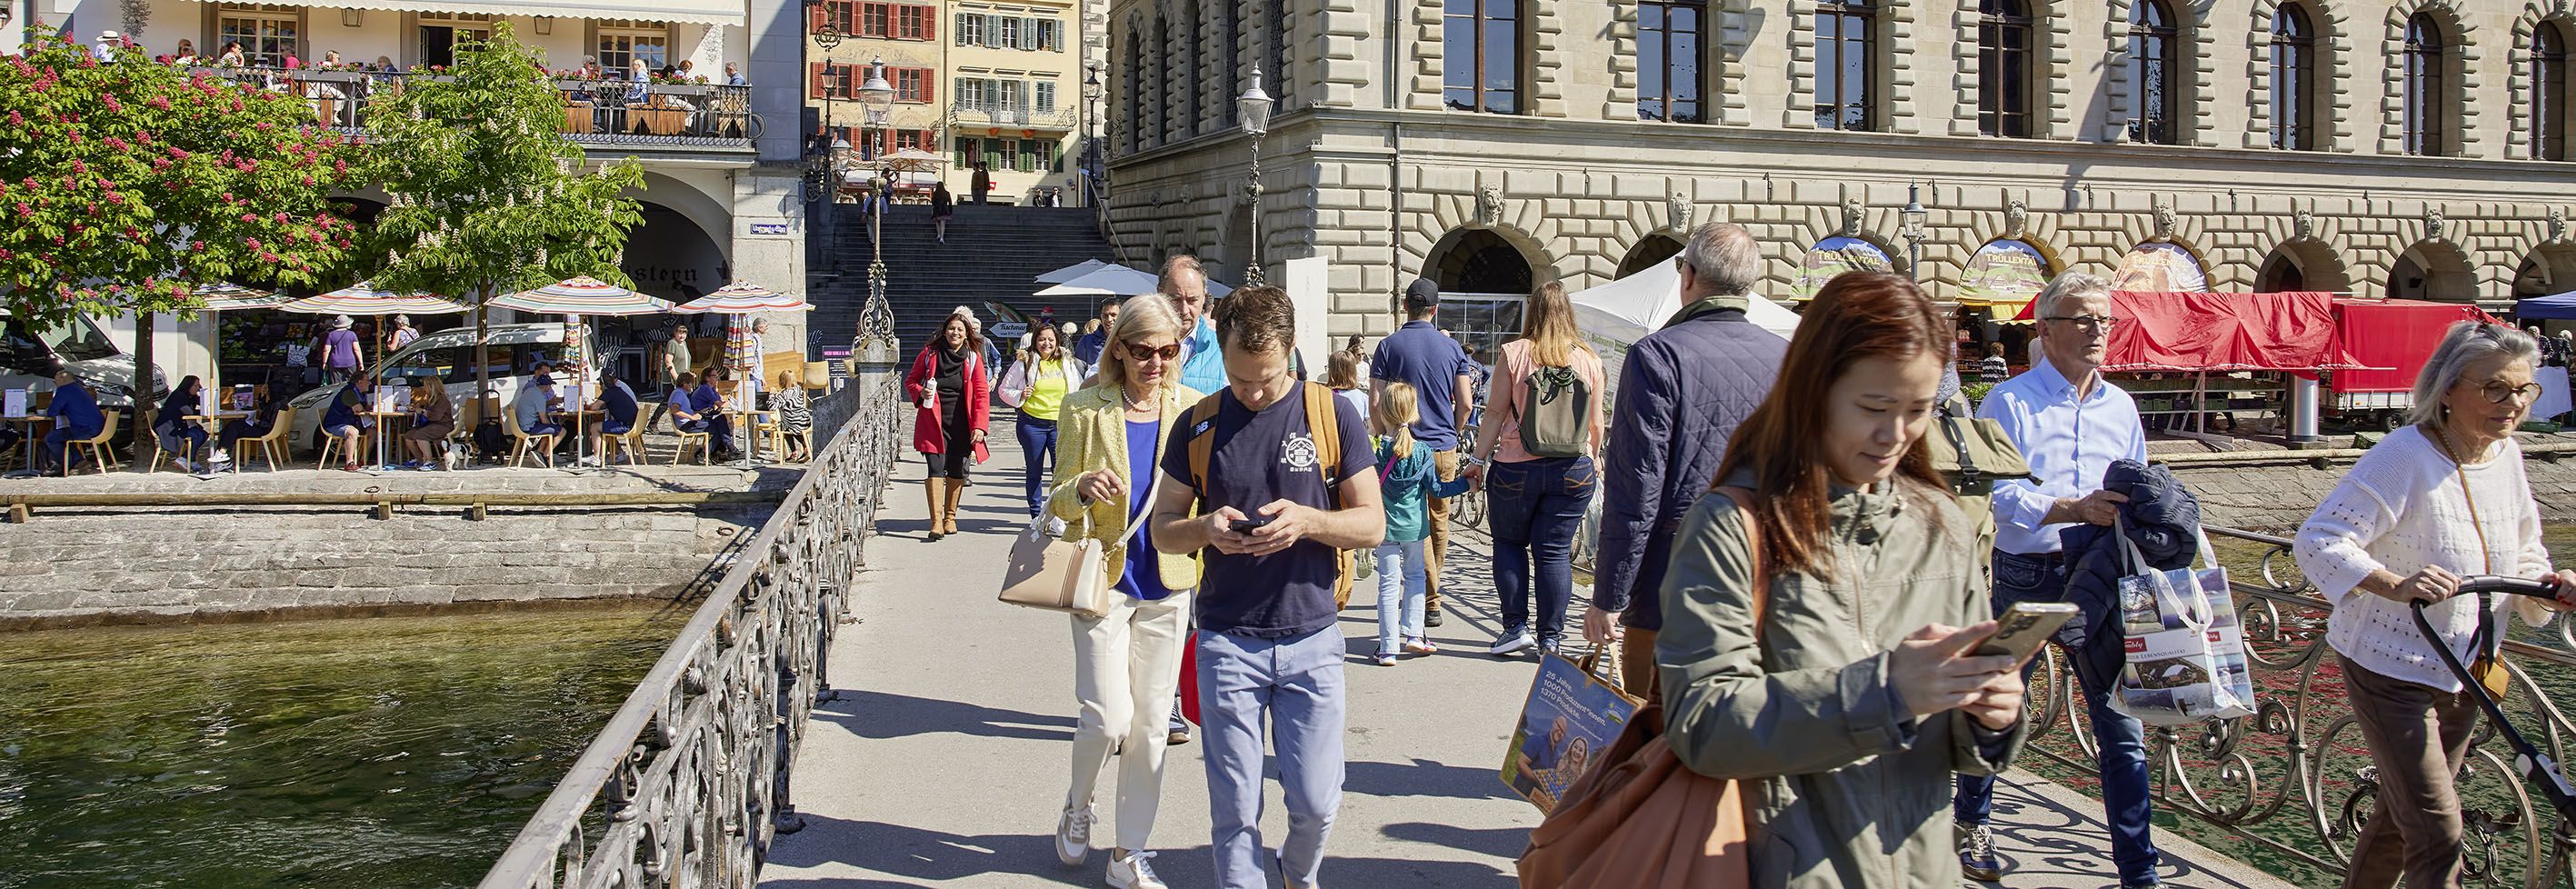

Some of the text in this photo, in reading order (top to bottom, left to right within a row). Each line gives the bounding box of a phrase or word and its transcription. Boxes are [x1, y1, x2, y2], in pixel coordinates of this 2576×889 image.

[1543, 679, 1562, 693] 1000
[1545, 671, 1573, 692] 25 Jahre.
[1541, 687, 1581, 720] 1370 Produkte.
